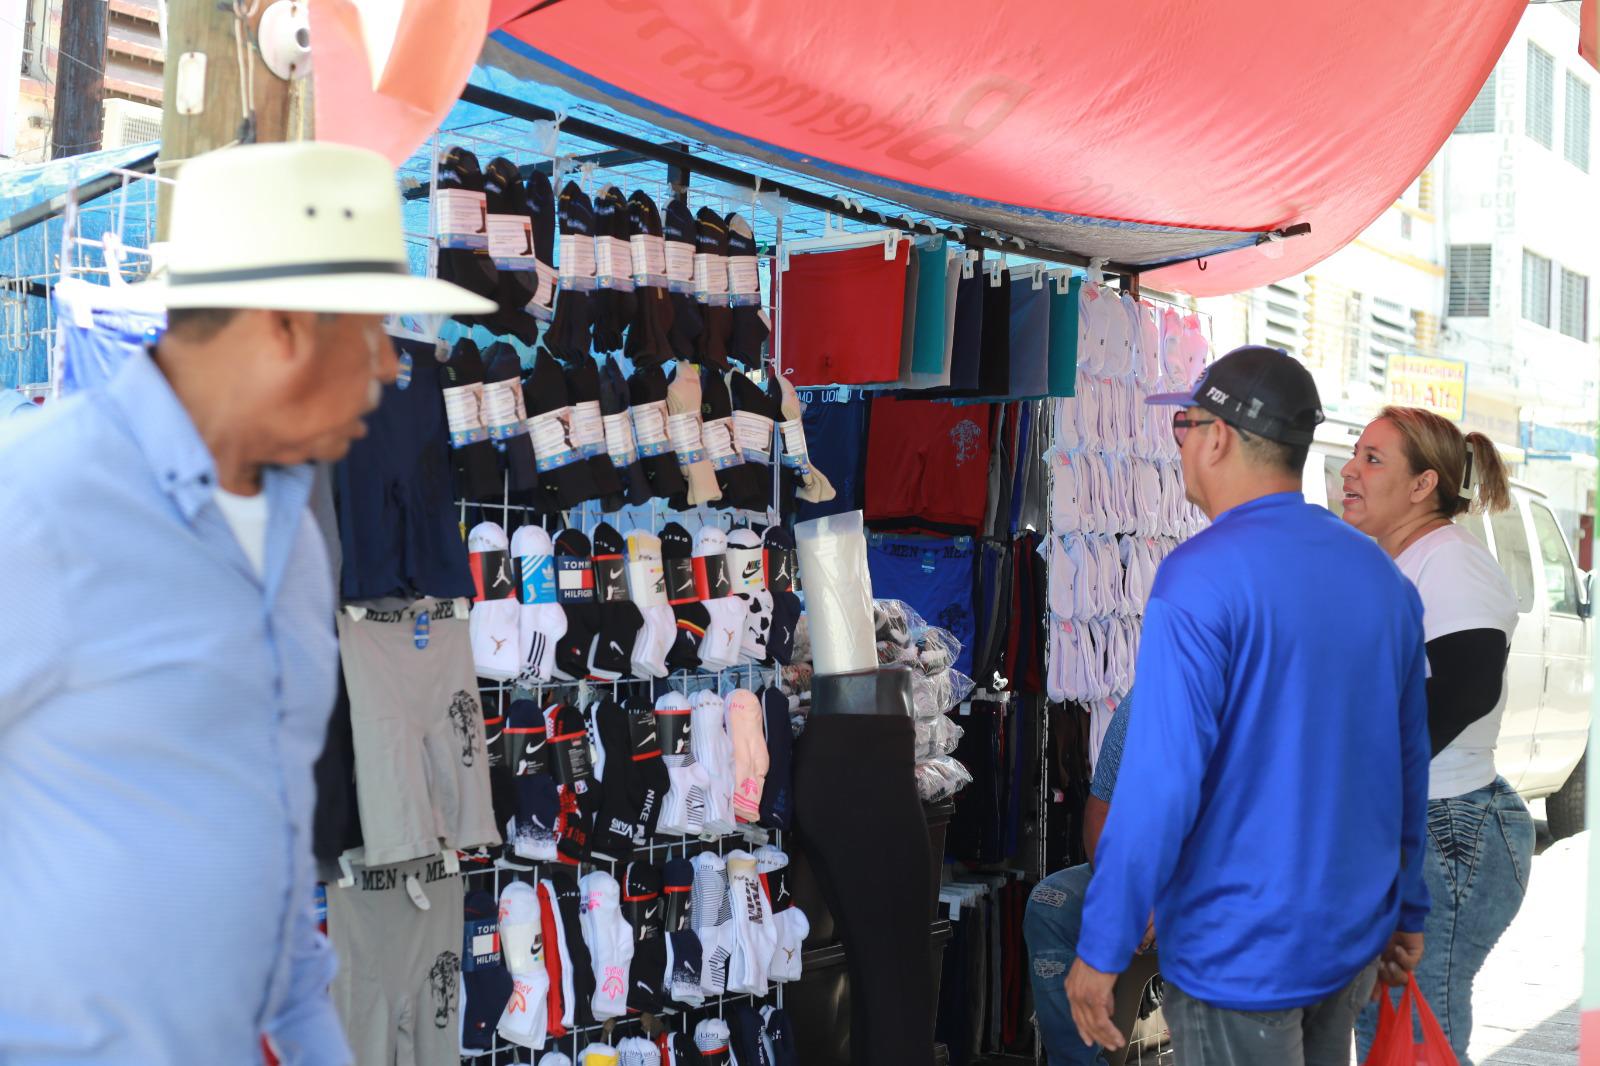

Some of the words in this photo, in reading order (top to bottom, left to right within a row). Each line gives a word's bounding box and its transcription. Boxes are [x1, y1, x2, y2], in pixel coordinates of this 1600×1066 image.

[821, 389, 852, 403] UO
[1206, 387, 1229, 405] FOX
[564, 560, 592, 569] TOMM
[564, 590, 593, 599] HILFIG
[431, 601, 454, 620] ME
[639, 788, 655, 822] NIKE
[361, 868, 398, 891] MEN
[425, 859, 458, 883] ME
[477, 924, 500, 934] TOM
